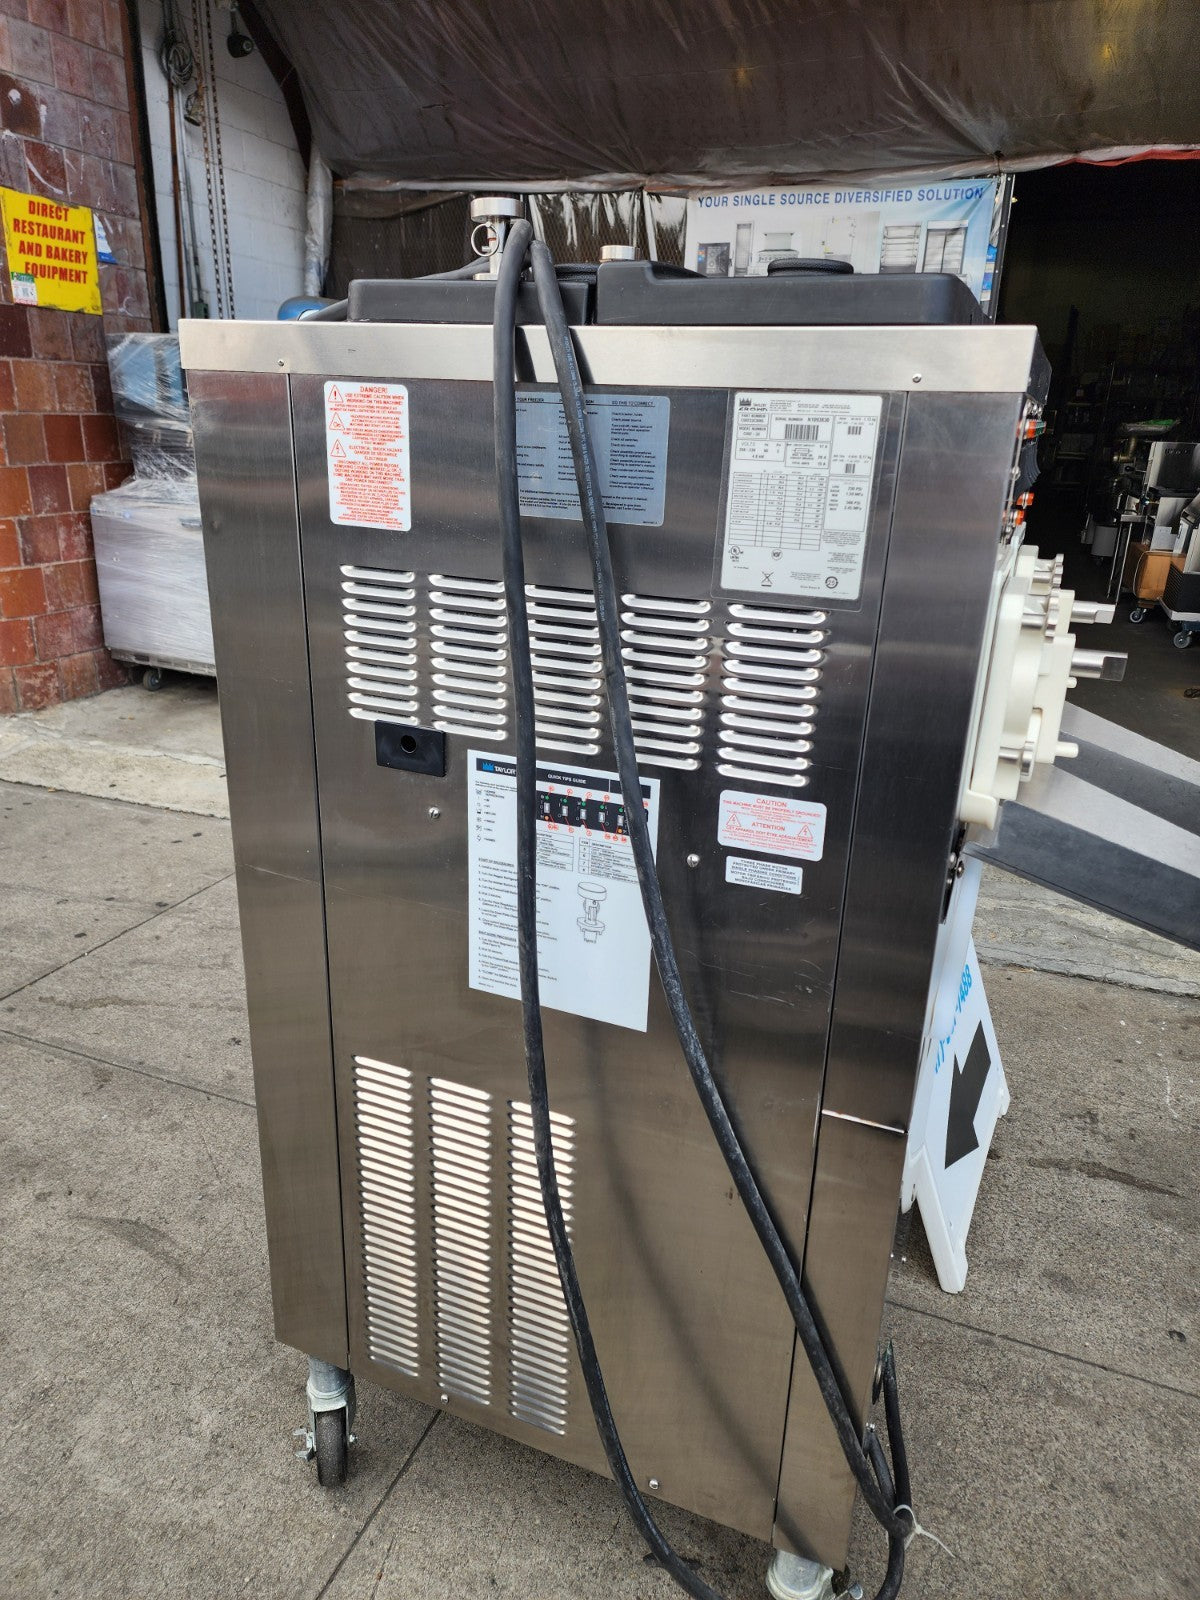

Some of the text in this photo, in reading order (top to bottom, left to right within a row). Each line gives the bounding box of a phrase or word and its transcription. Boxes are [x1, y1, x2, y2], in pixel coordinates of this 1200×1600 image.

[698, 187, 983, 208] YOUR SINGLE SOURCE DIVERSIFIED SOLUTION
[29, 200, 69, 222] DIRECT
[13, 218, 86, 244] RESTAURANT
[19, 240, 88, 265] AND BAKERY
[24, 262, 88, 284] EQUIPMENT
[547, 773, 562, 781] QUICK
[756, 798, 788, 807] CAUTION
[752, 821, 786, 831] ATTENTION
